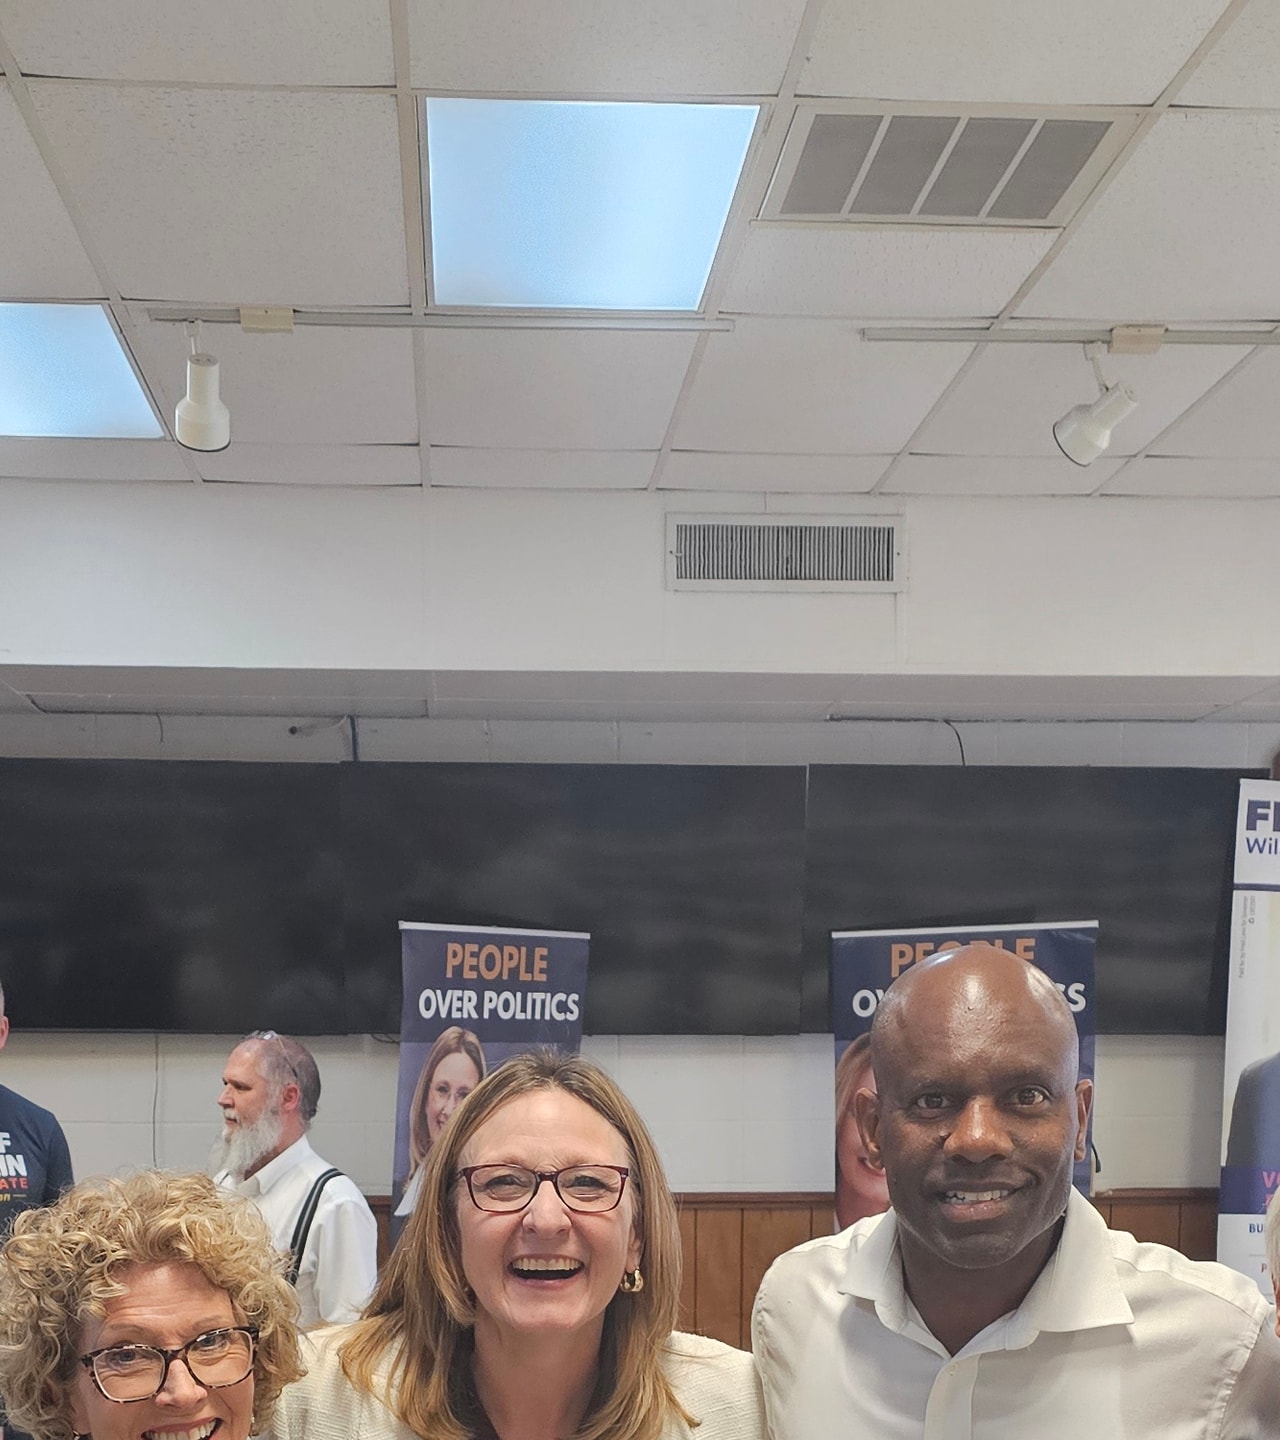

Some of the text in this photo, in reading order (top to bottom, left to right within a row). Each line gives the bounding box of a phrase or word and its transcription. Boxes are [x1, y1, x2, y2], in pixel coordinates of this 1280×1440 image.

[445, 942, 549, 982] PEOPLE
[418, 988, 580, 1021] OVER POLITICS
